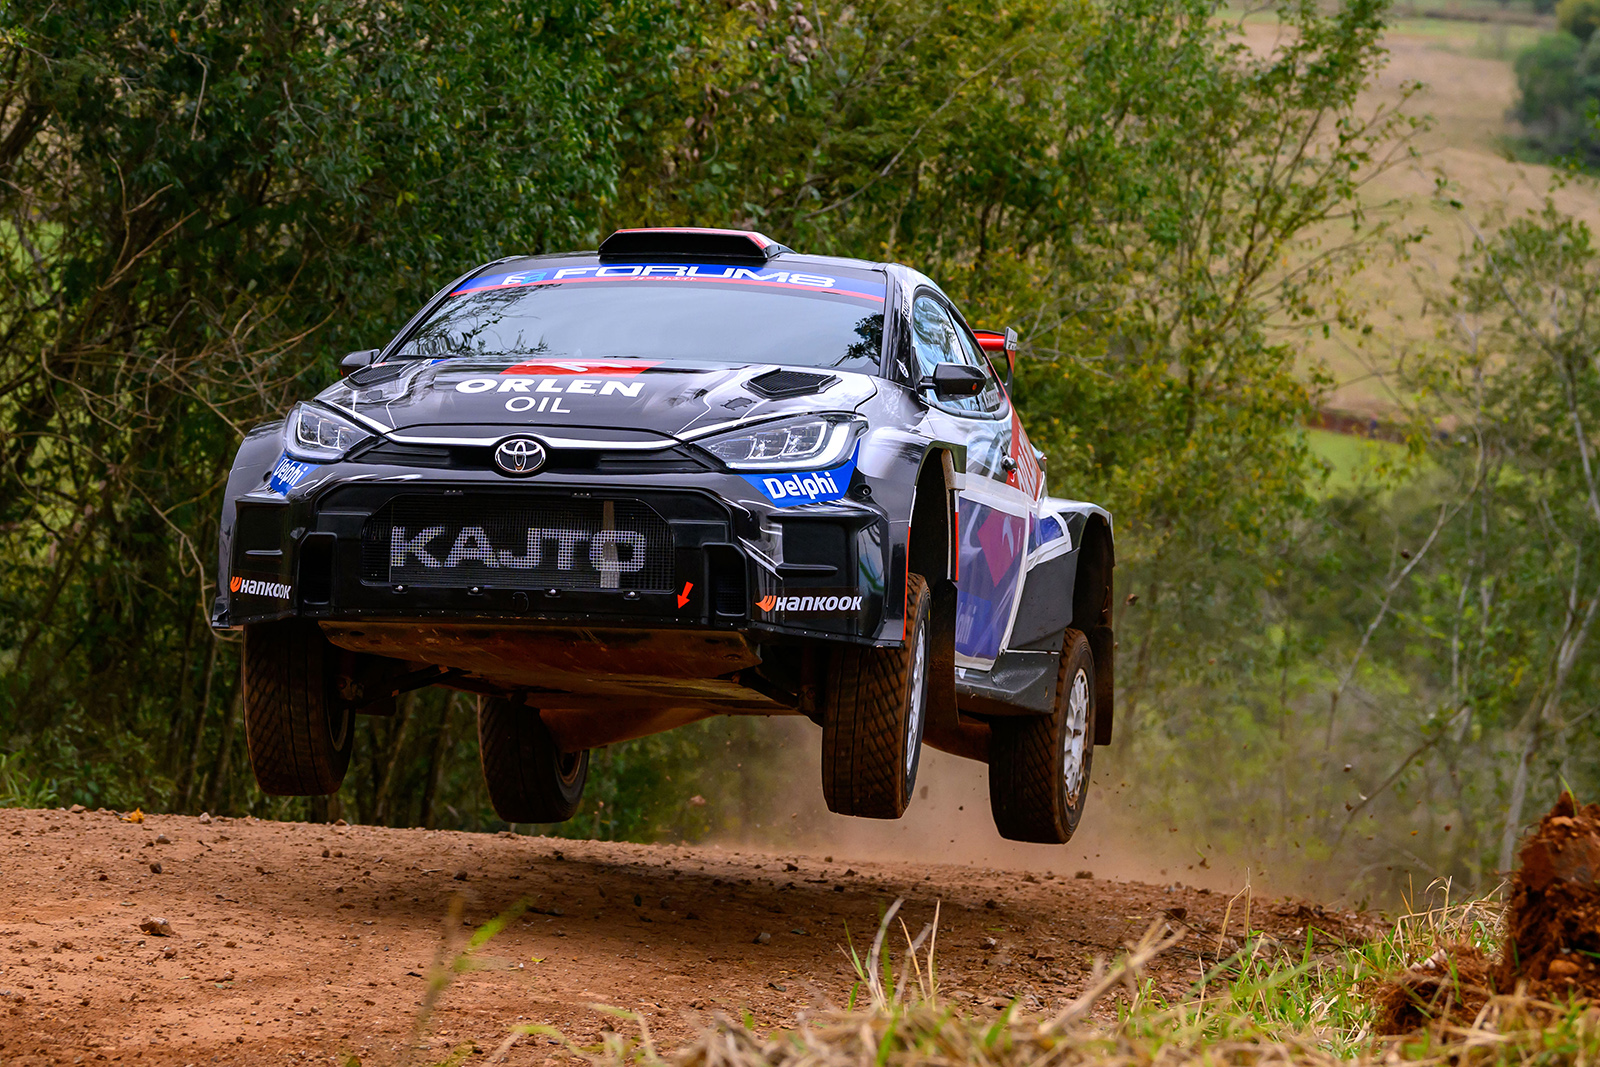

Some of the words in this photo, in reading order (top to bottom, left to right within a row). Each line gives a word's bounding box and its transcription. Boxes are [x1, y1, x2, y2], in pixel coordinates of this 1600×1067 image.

[553, 265, 836, 288] FORUM8
[455, 378, 646, 398] ORLEN
[504, 396, 571, 414] OIL
[273, 458, 309, 486] Delphi
[762, 471, 839, 500] Delphi
[390, 525, 646, 572] KAJTO
